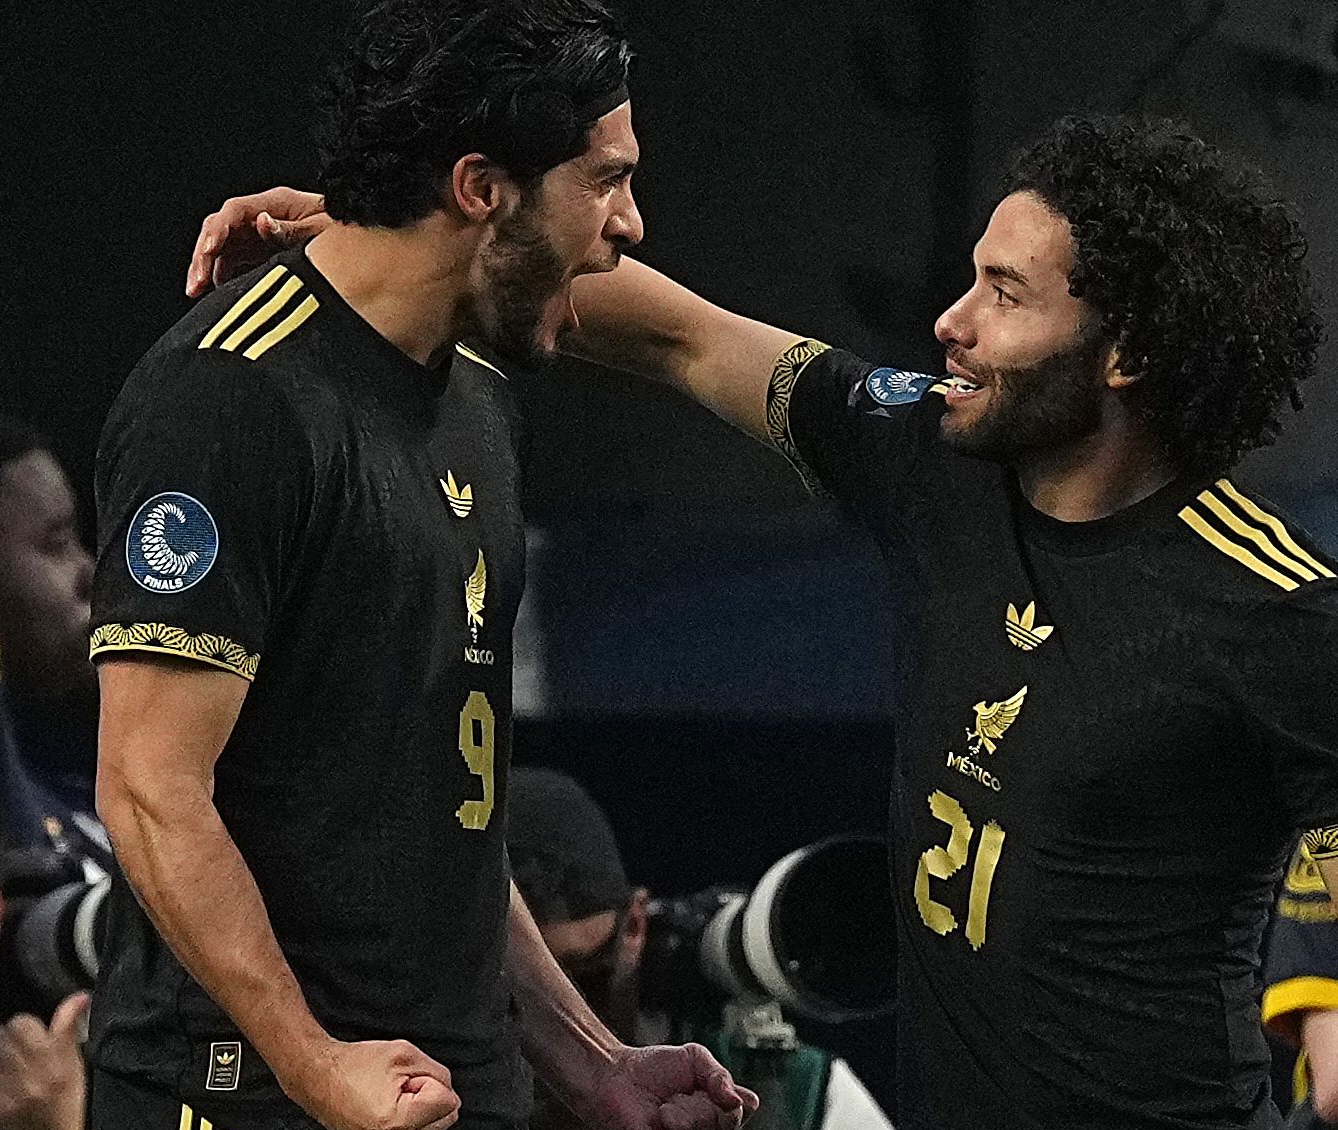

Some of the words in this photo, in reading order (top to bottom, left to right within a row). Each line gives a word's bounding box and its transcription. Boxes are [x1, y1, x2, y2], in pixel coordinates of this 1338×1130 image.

[143, 574, 184, 591] FINALS
[455, 691, 495, 831] 9
[946, 751, 1002, 792] MÉXICO
[913, 788, 1006, 951] 21
